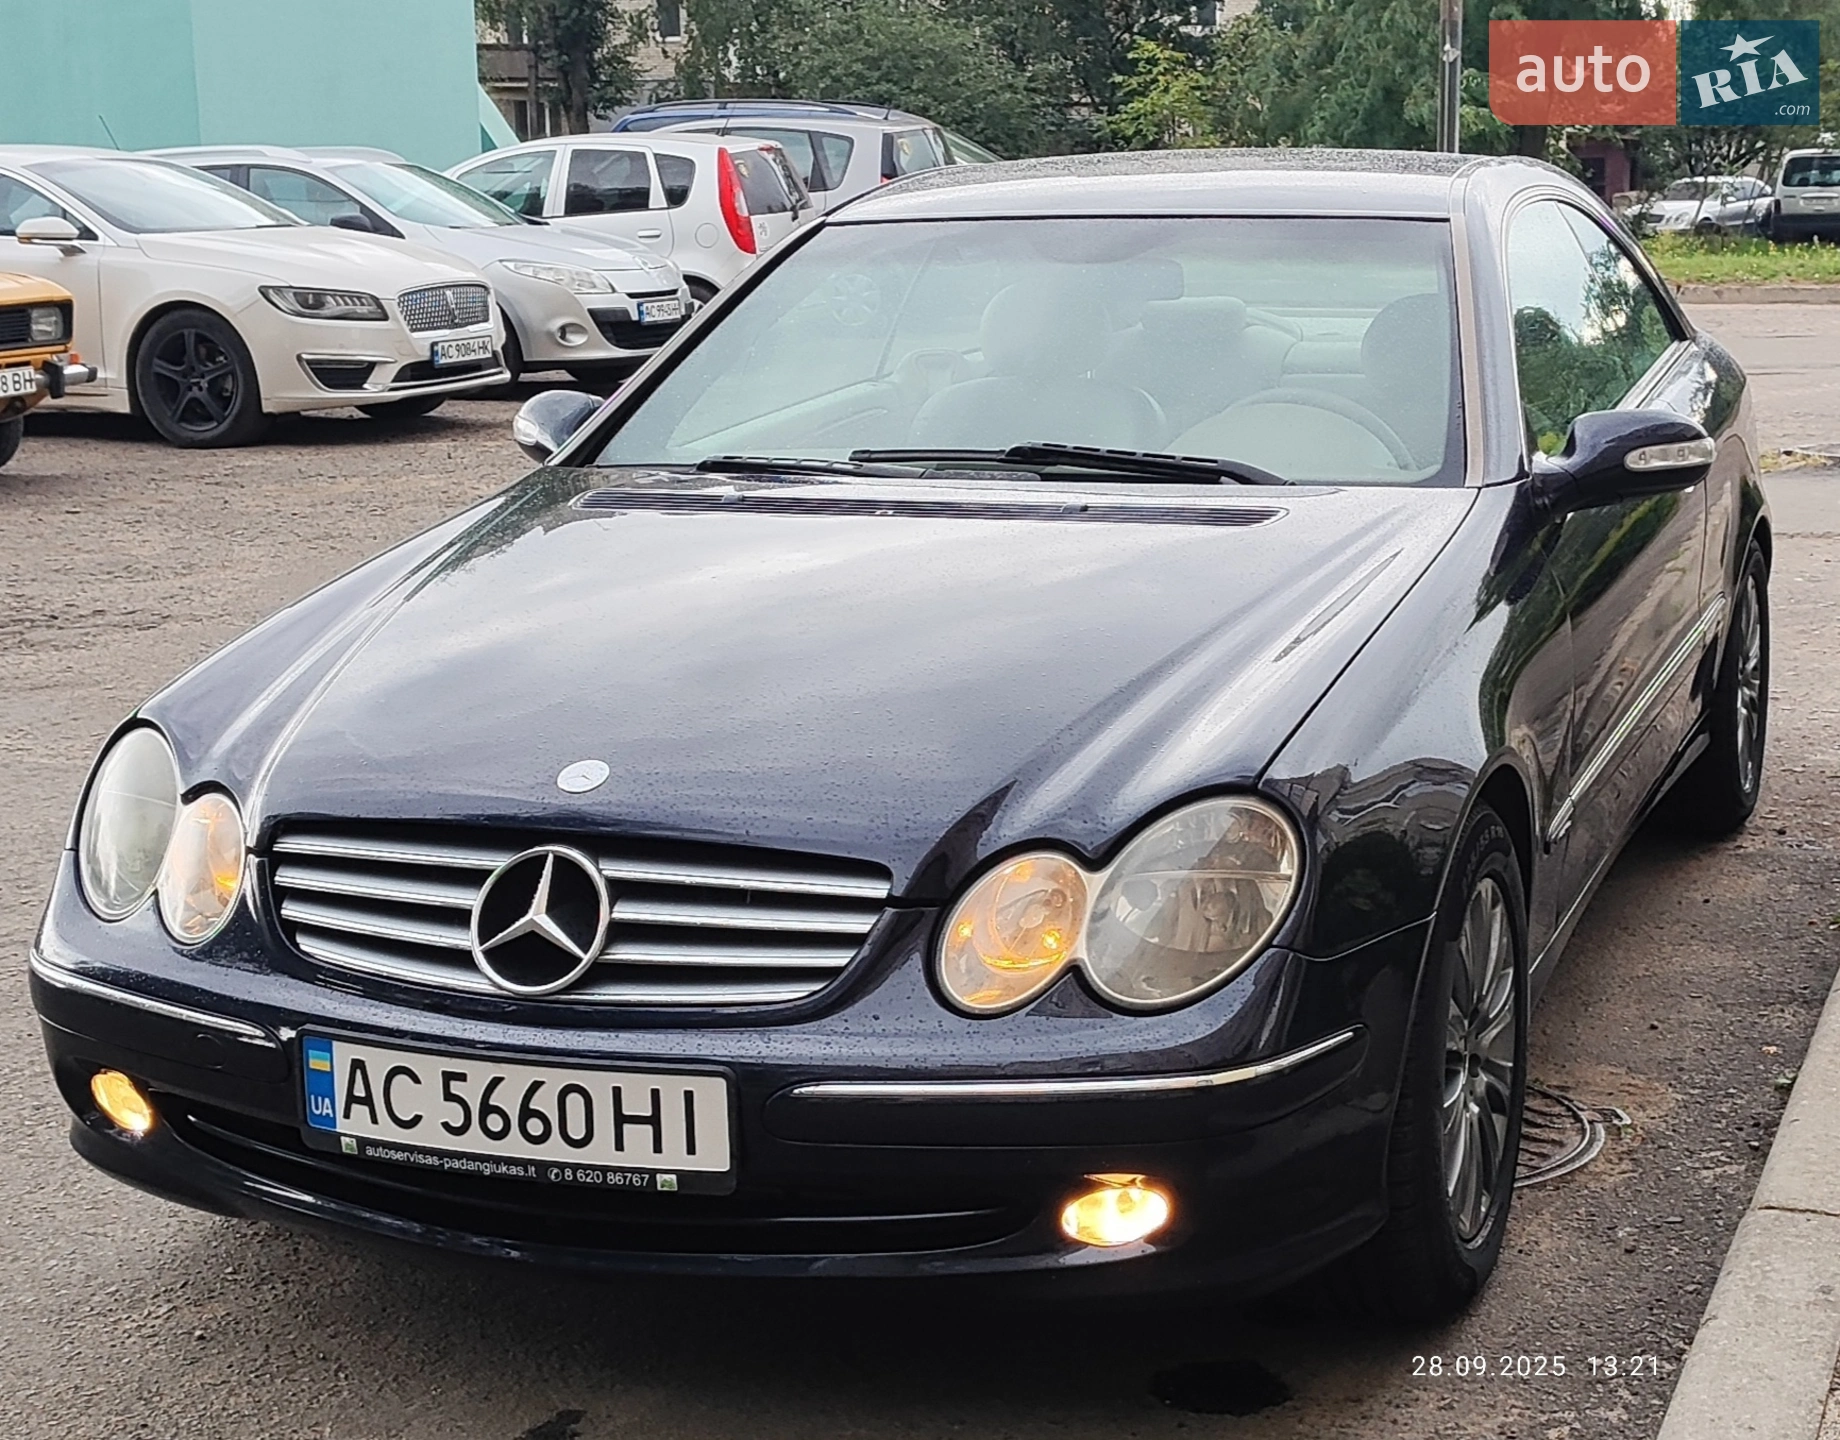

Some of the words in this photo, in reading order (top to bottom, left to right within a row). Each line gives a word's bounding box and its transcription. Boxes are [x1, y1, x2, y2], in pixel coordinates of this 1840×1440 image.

[441, 344, 454, 360] AC
[455, 341, 477, 359] 9084
[477, 340, 491, 355] HK
[12, 370, 34, 392] BH
[311, 1095, 334, 1119] UA
[342, 1058, 424, 1130] AC
[440, 1070, 595, 1149] 5660
[611, 1085, 697, 1156] HI
[365, 1143, 537, 1179] autoservisas-padangiukas.lt
[564, 1168, 573, 1181] 8
[576, 1169, 603, 1184] 620
[606, 1171, 650, 1188] 86767
